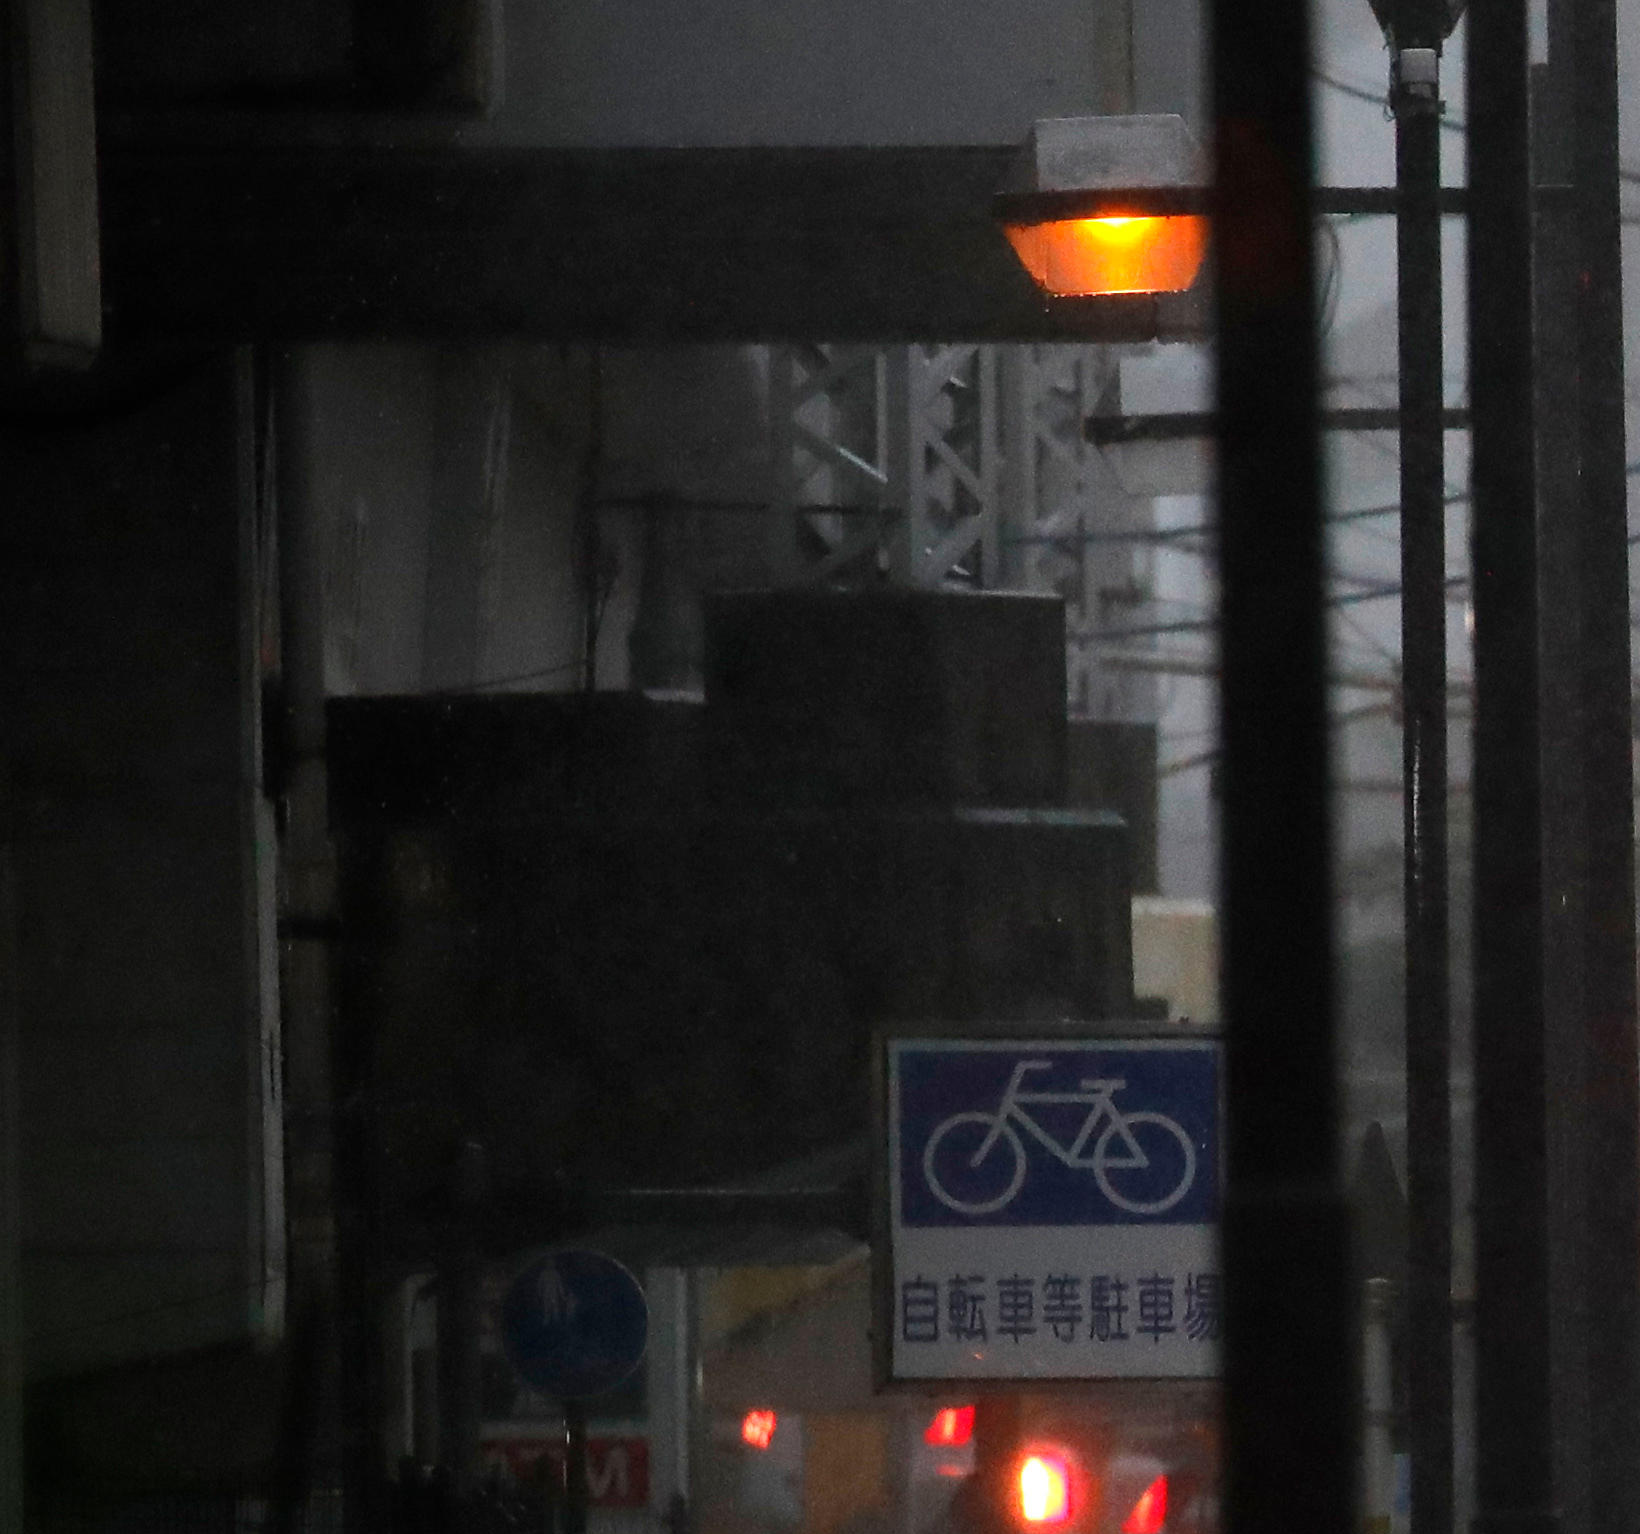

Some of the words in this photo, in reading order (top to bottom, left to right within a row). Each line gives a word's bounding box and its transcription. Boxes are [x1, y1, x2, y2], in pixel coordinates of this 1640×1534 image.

[901, 1273, 1219, 1345] 自転車等駐車場
